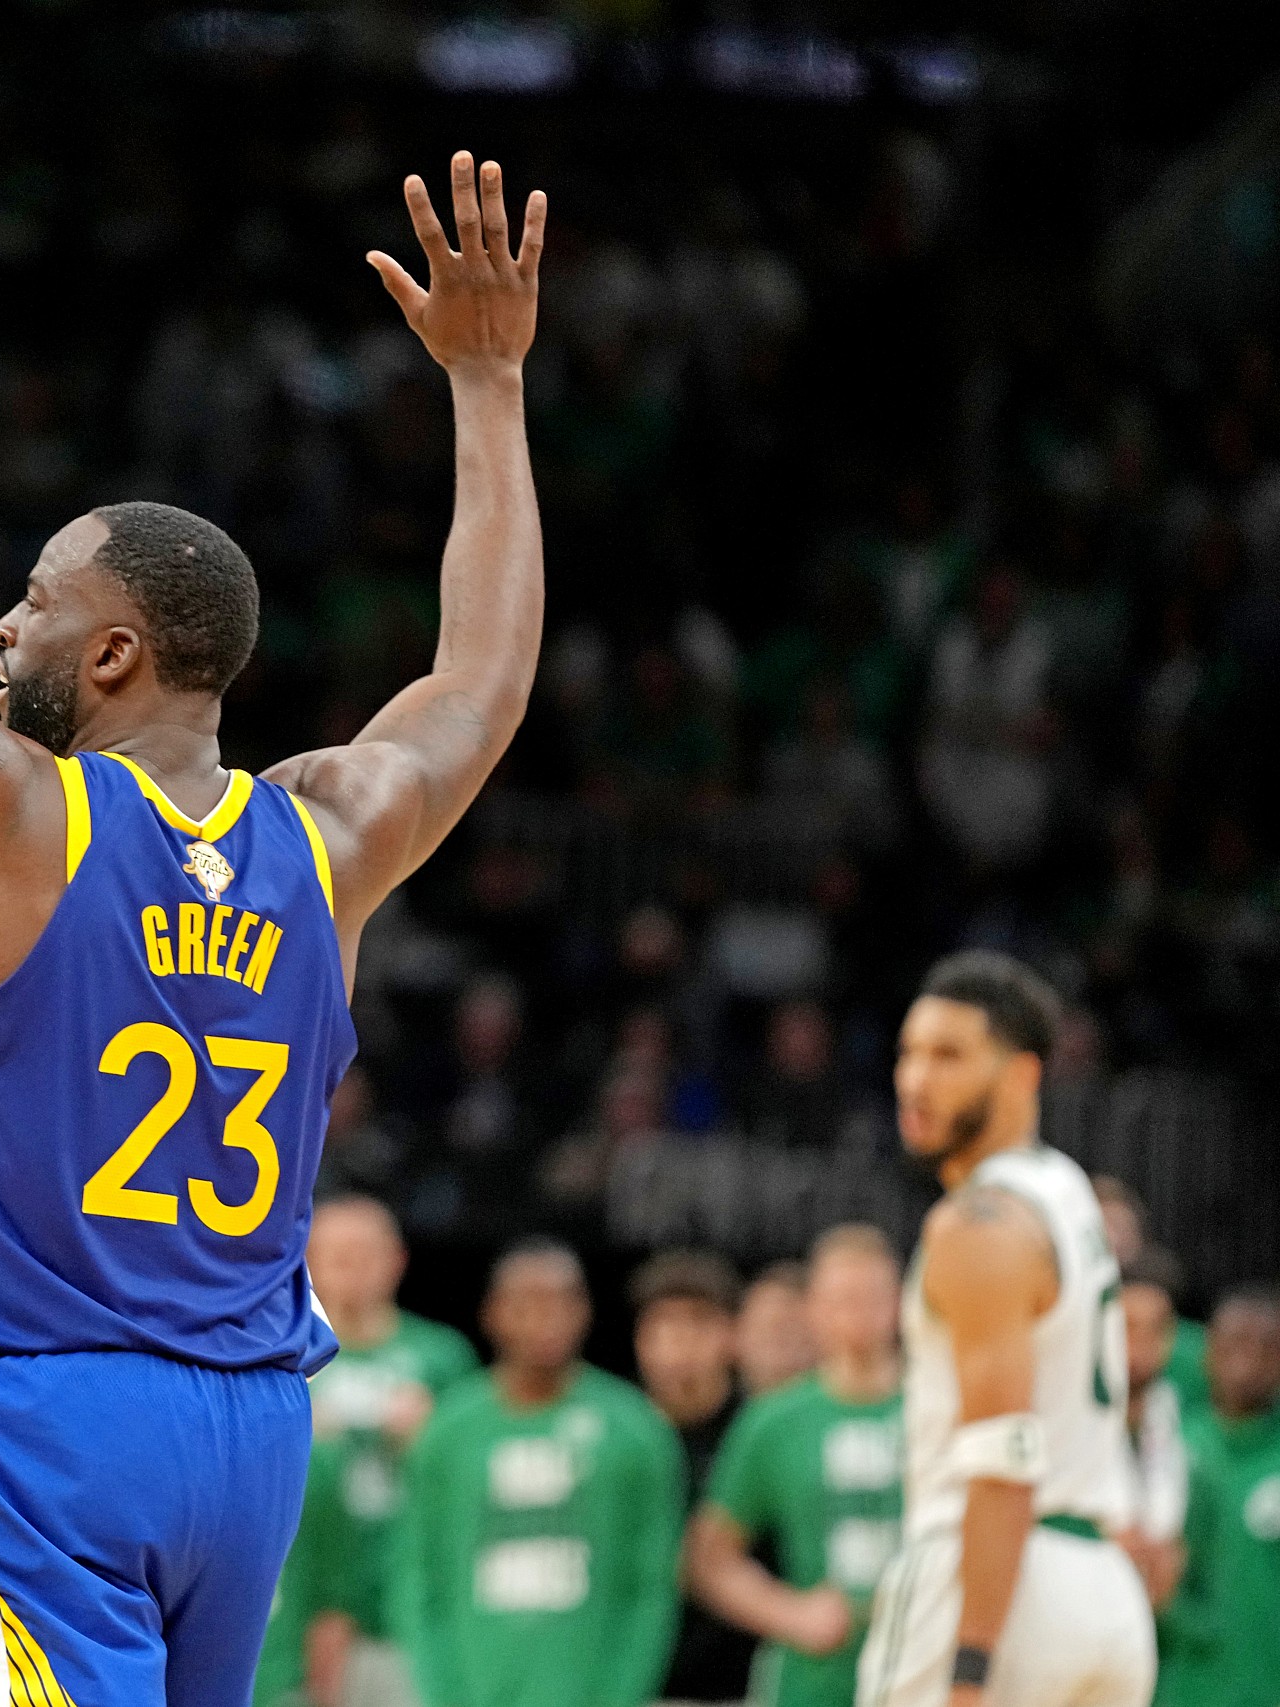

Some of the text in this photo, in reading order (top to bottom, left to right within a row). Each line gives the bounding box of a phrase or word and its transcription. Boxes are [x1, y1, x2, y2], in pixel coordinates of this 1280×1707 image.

[184, 847, 231, 877] Finals
[142, 902, 284, 996] GREEN
[82, 1021, 290, 1237] 23
